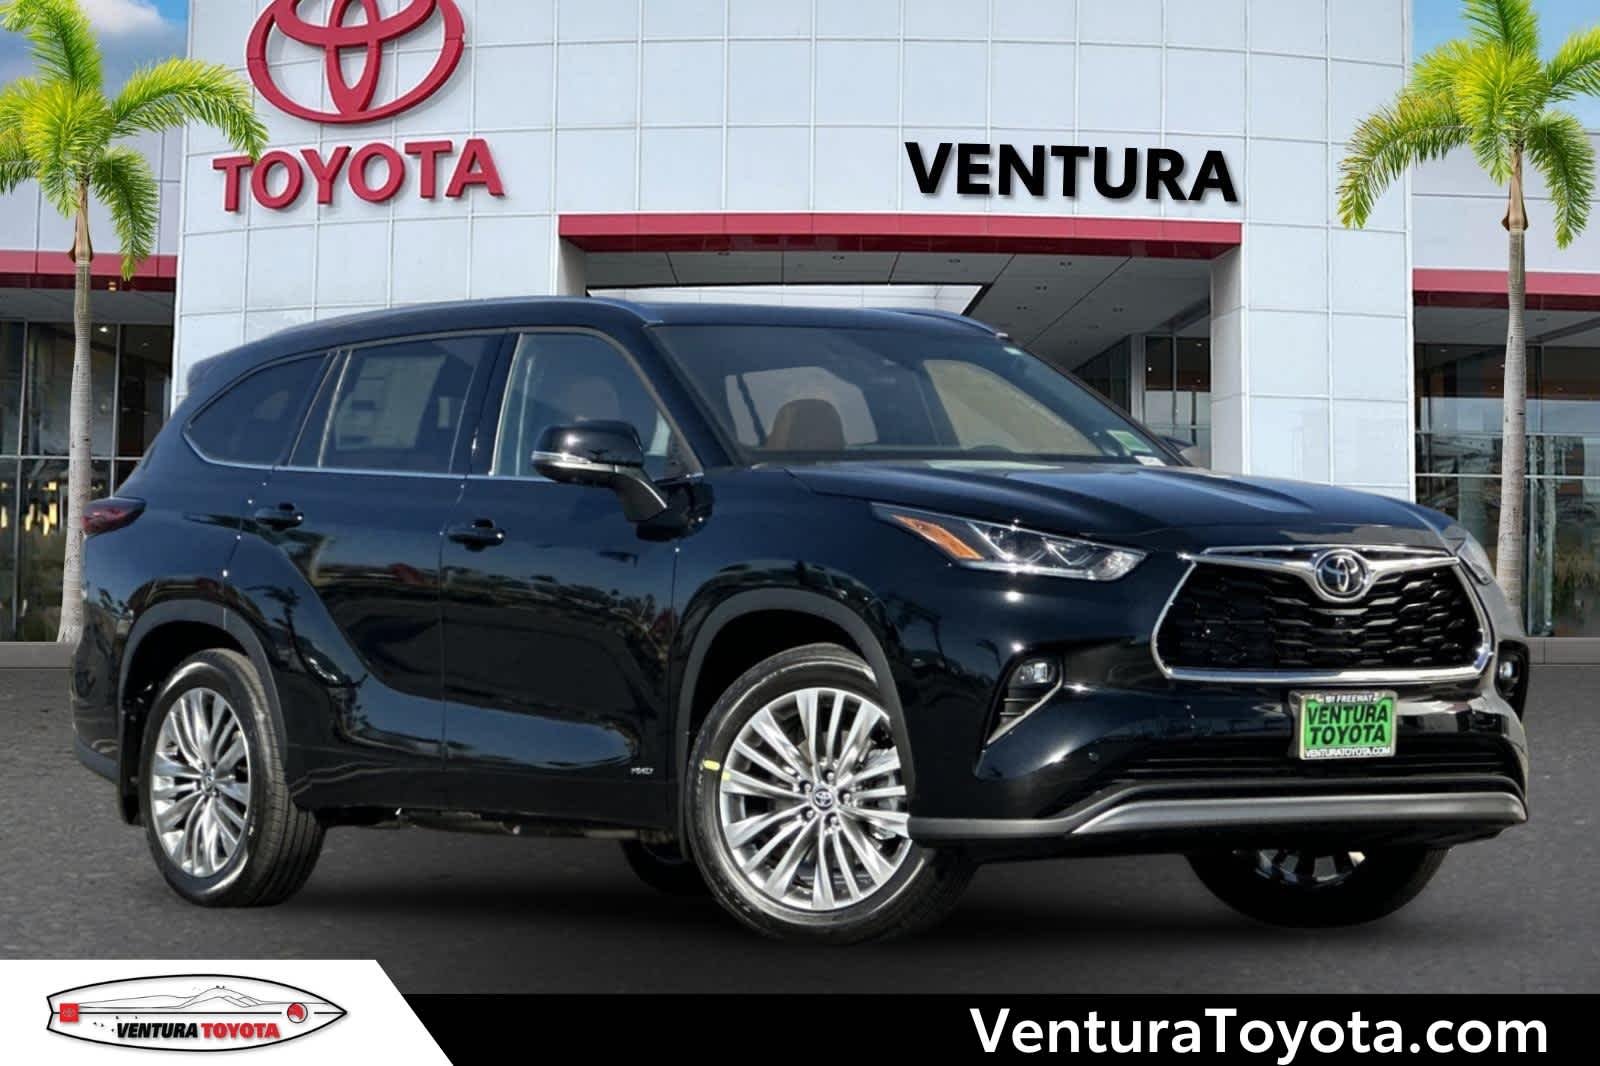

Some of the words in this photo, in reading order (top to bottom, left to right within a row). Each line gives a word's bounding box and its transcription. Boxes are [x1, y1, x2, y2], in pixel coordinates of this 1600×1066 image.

[212, 138, 505, 213] TOYOTA
[904, 142, 1239, 203] VENTURA
[1307, 703, 1389, 725] VENTURA
[1310, 724, 1386, 745] TOYOTA
